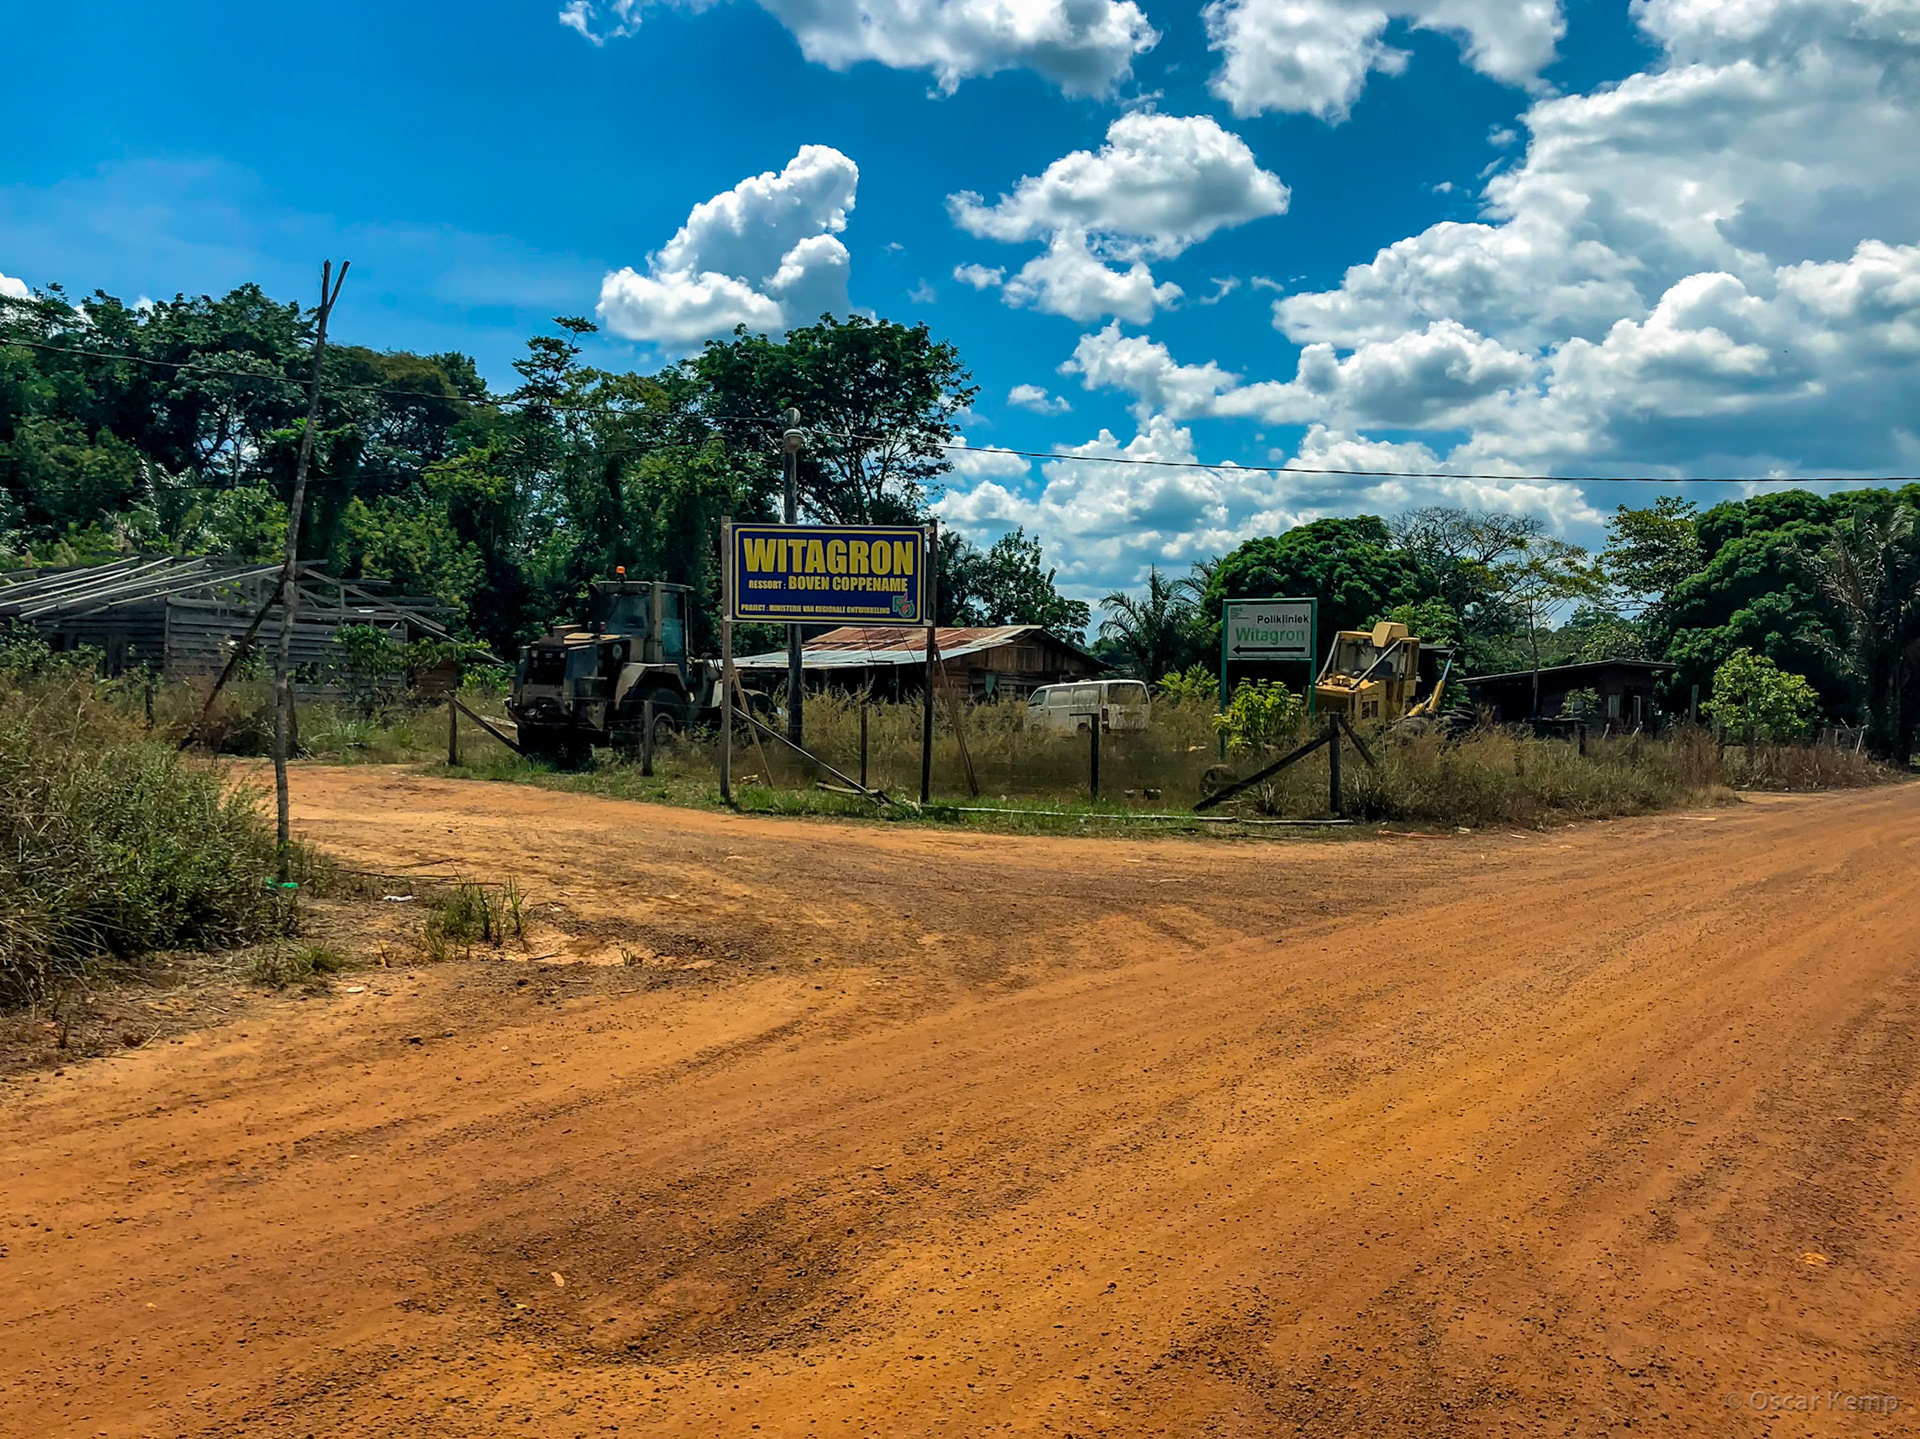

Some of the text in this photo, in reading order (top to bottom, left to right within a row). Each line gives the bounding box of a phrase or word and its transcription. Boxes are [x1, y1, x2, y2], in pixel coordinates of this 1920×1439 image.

[743, 538, 914, 575] WITAGRON
[788, 576, 830, 591] BOVEN
[832, 577, 908, 592] COPPENAME
[1235, 627, 1305, 645] Witagron
